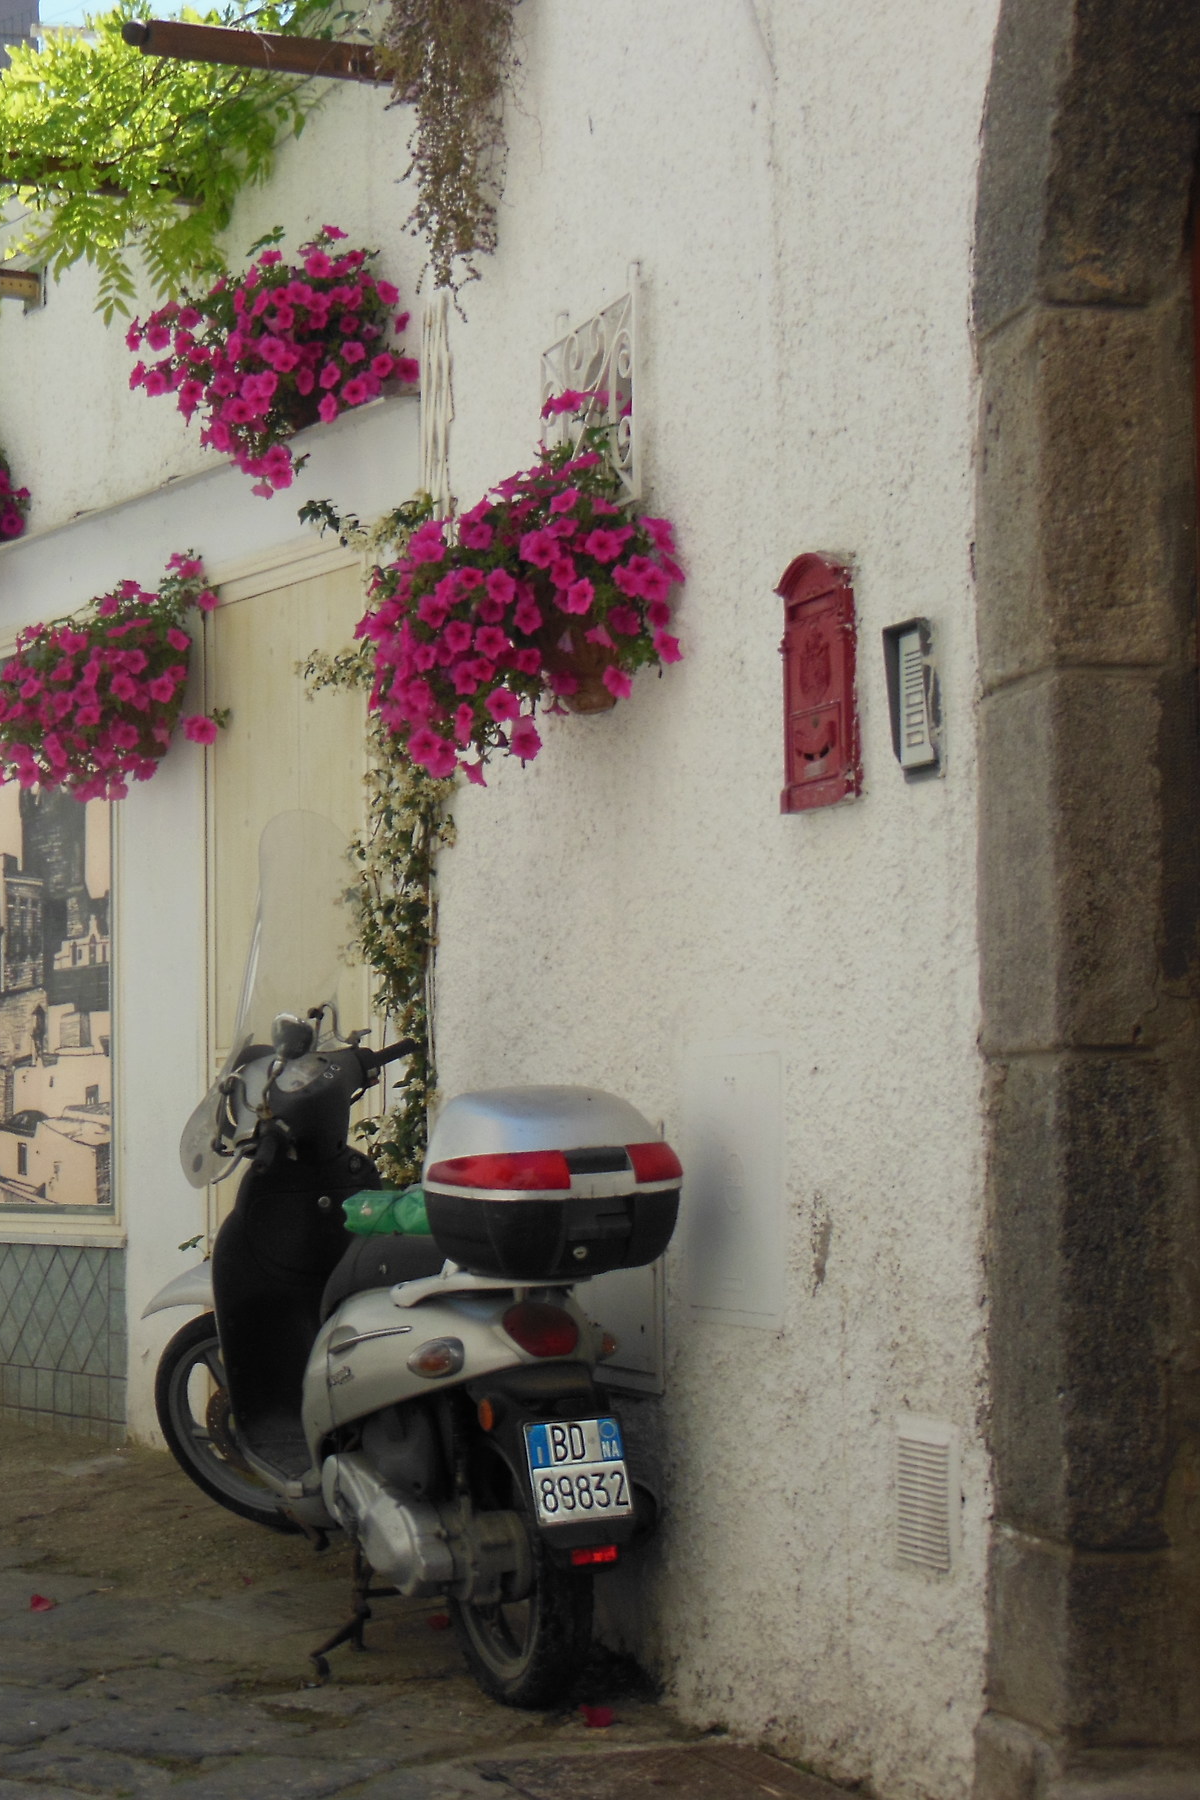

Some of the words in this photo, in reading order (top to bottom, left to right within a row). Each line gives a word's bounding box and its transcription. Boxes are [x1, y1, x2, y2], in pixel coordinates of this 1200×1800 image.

[550, 1422, 586, 1463] BD
[601, 1440, 620, 1458] NA
[540, 1470, 629, 1513] 89832
